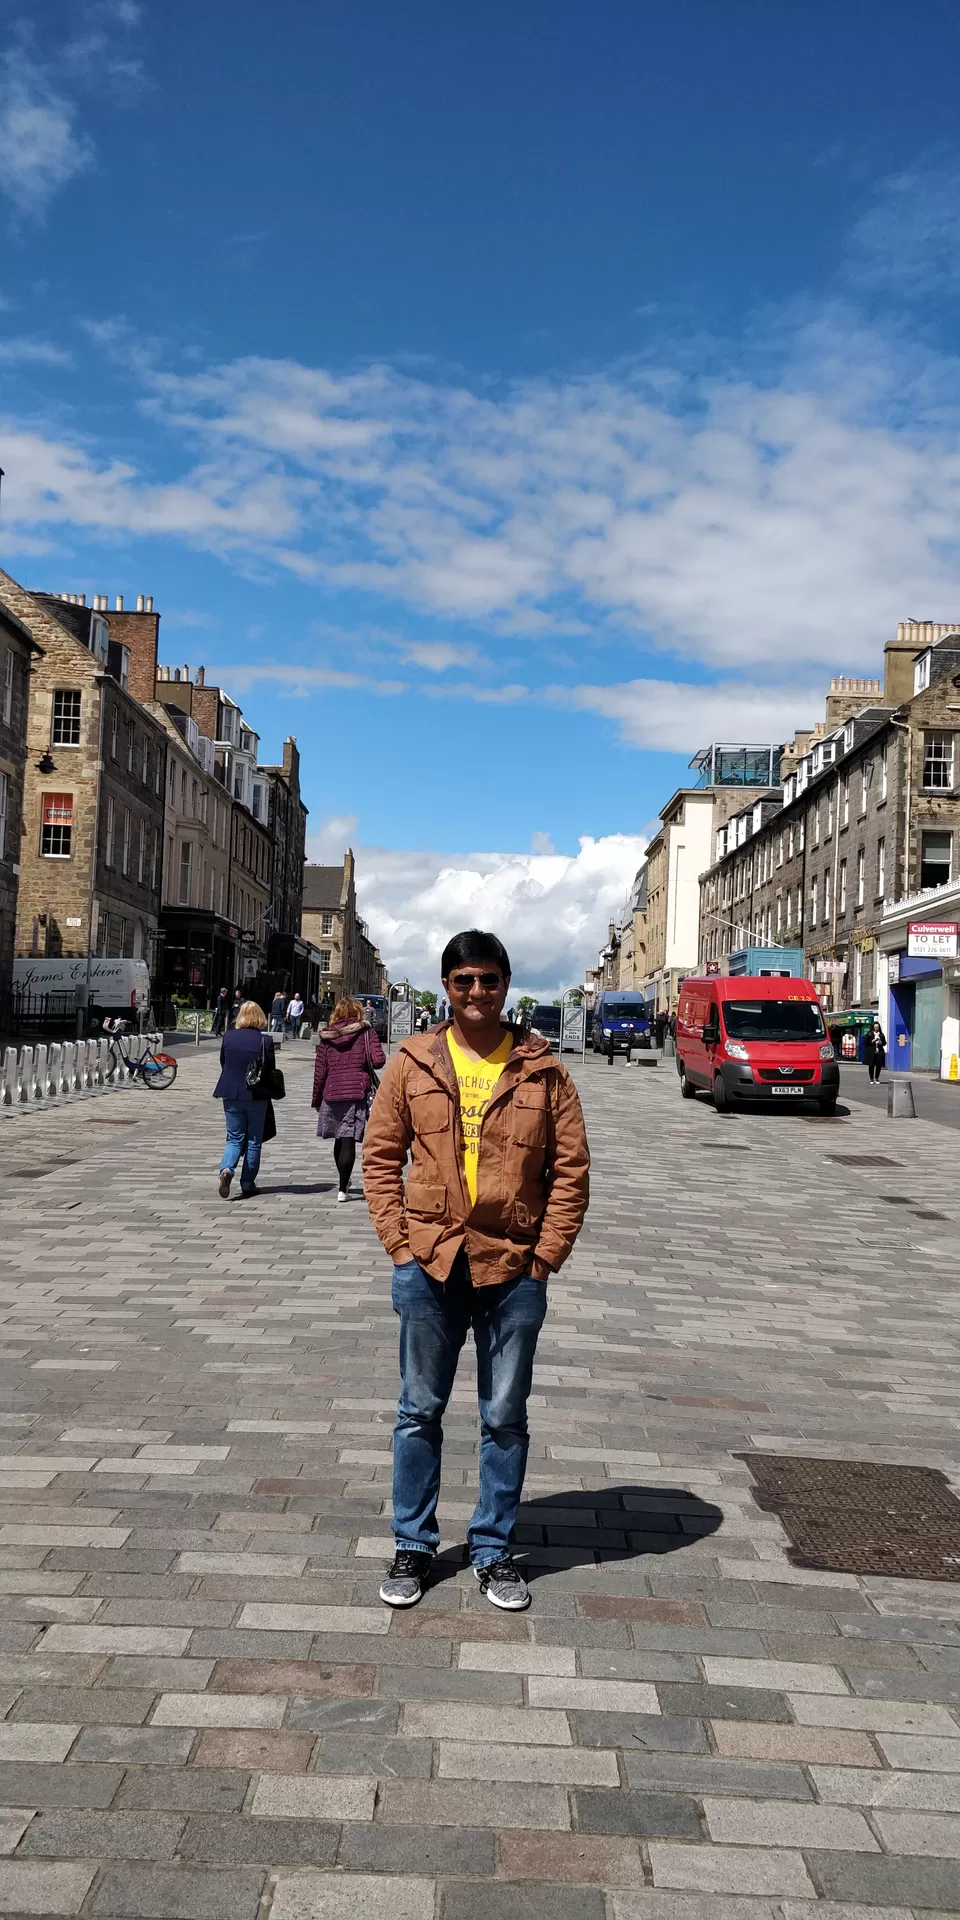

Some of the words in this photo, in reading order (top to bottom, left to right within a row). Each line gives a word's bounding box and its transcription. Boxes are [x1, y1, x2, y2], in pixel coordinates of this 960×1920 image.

[911, 924, 955, 933] Culverwell
[914, 935, 928, 943] TO
[932, 935, 951, 943] LET
[21, 966, 63, 990] James
